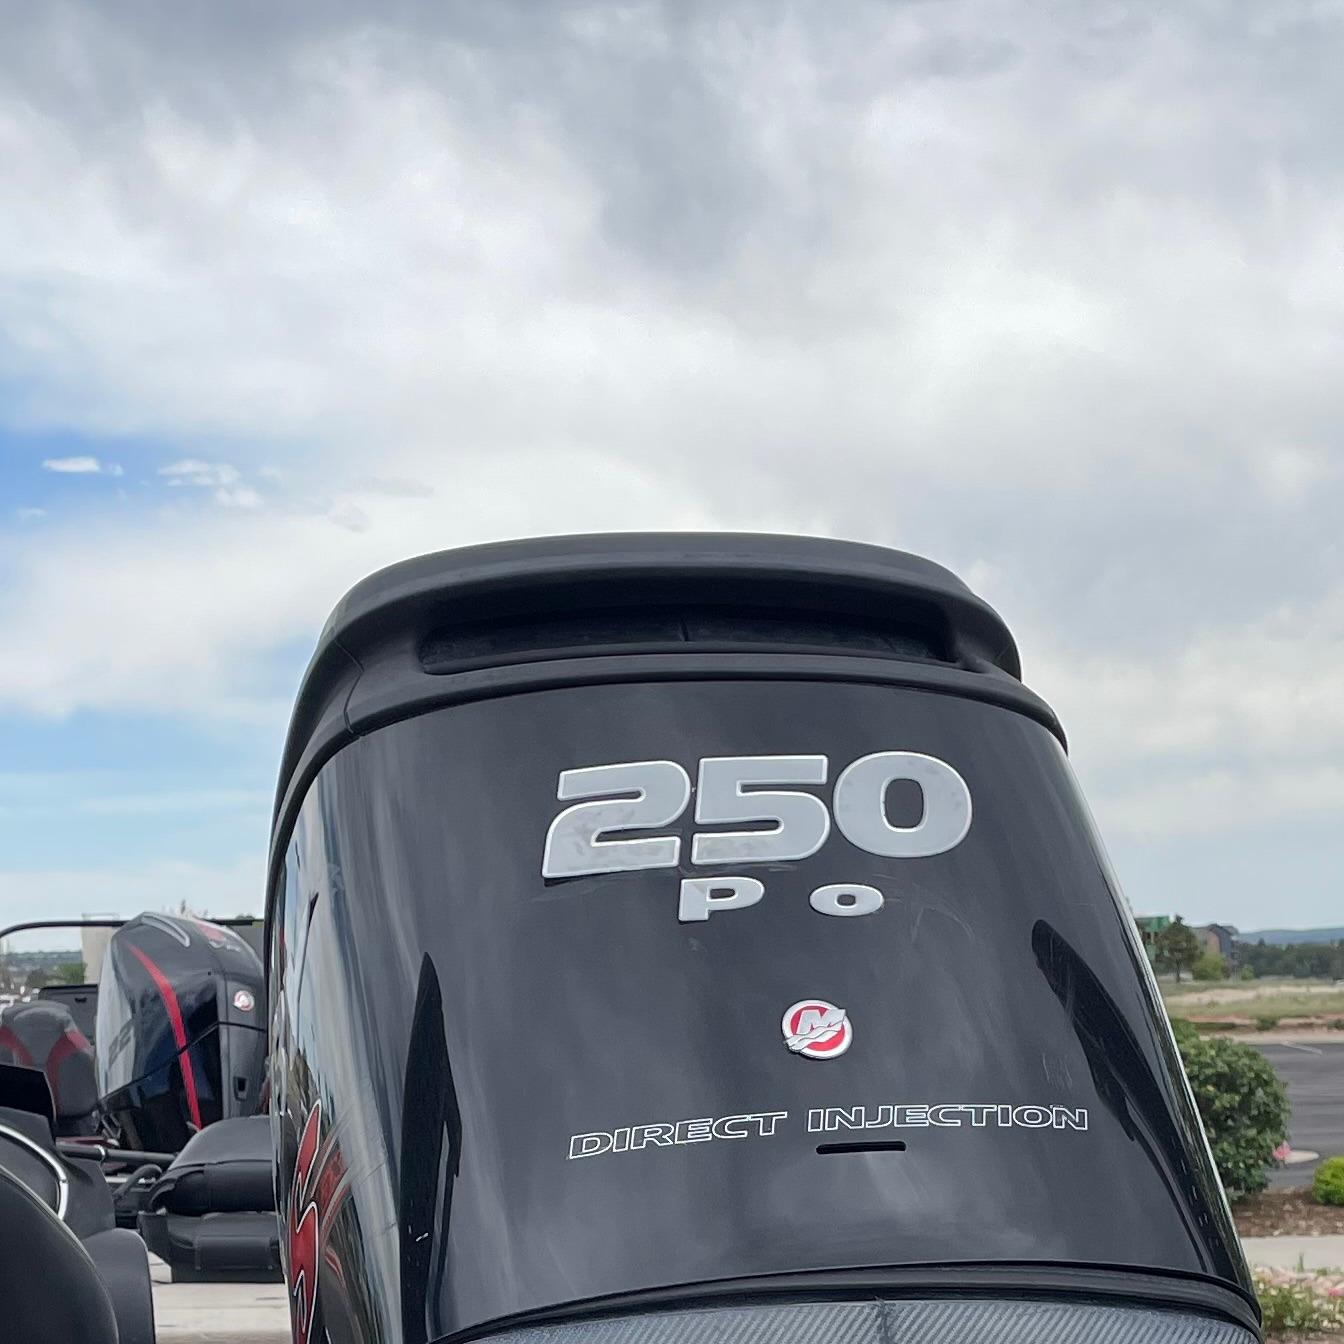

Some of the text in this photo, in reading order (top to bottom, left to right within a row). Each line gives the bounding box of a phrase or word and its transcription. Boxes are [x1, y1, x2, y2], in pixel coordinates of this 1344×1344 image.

[542, 750, 973, 879] 250
[678, 877, 765, 922] P
[567, 1104, 1089, 1160] DIRECT INJECTION
